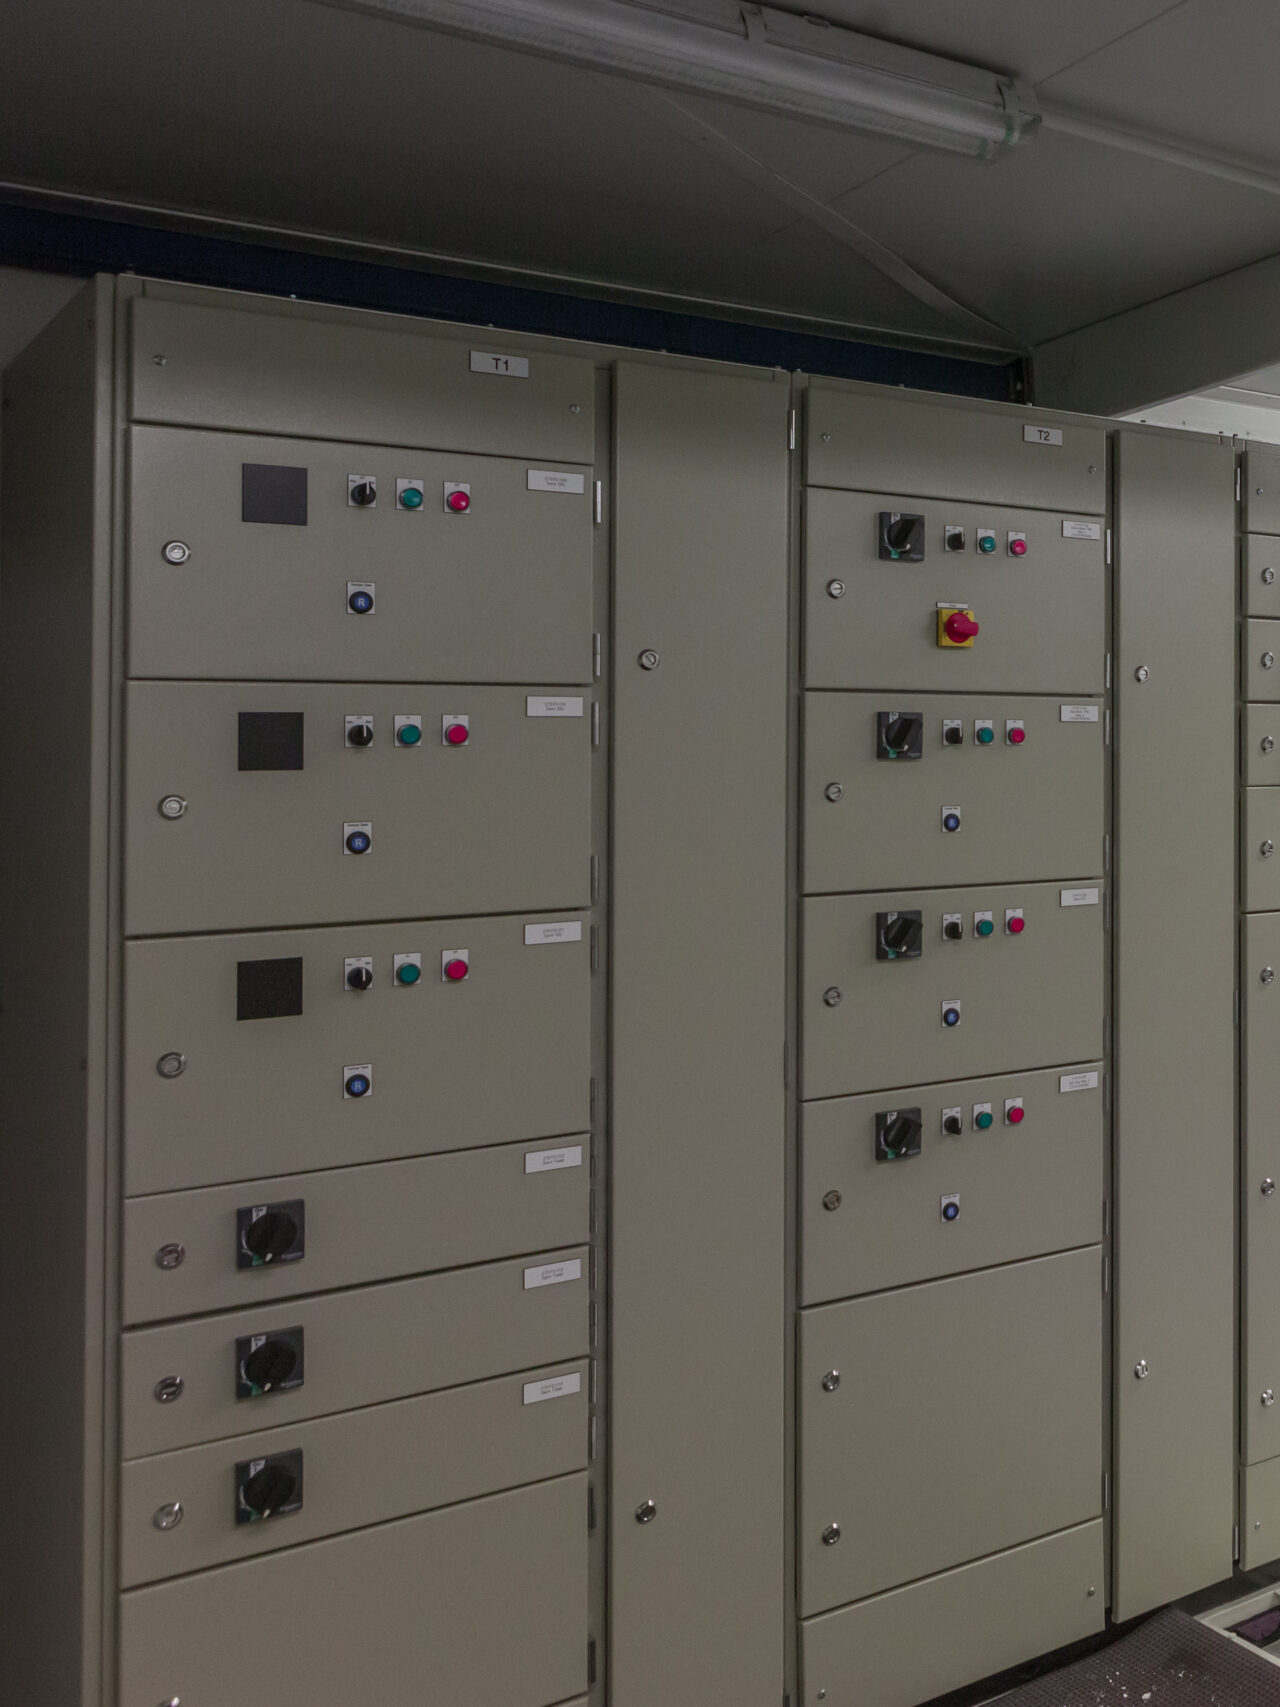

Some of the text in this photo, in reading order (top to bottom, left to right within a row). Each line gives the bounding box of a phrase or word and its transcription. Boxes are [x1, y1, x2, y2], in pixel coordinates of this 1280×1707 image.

[492, 357, 510, 372] T1
[1037, 429, 1050, 442] T2
[358, 598, 365, 607] R
[355, 838, 362, 847] R
[354, 1081, 362, 1090] R
